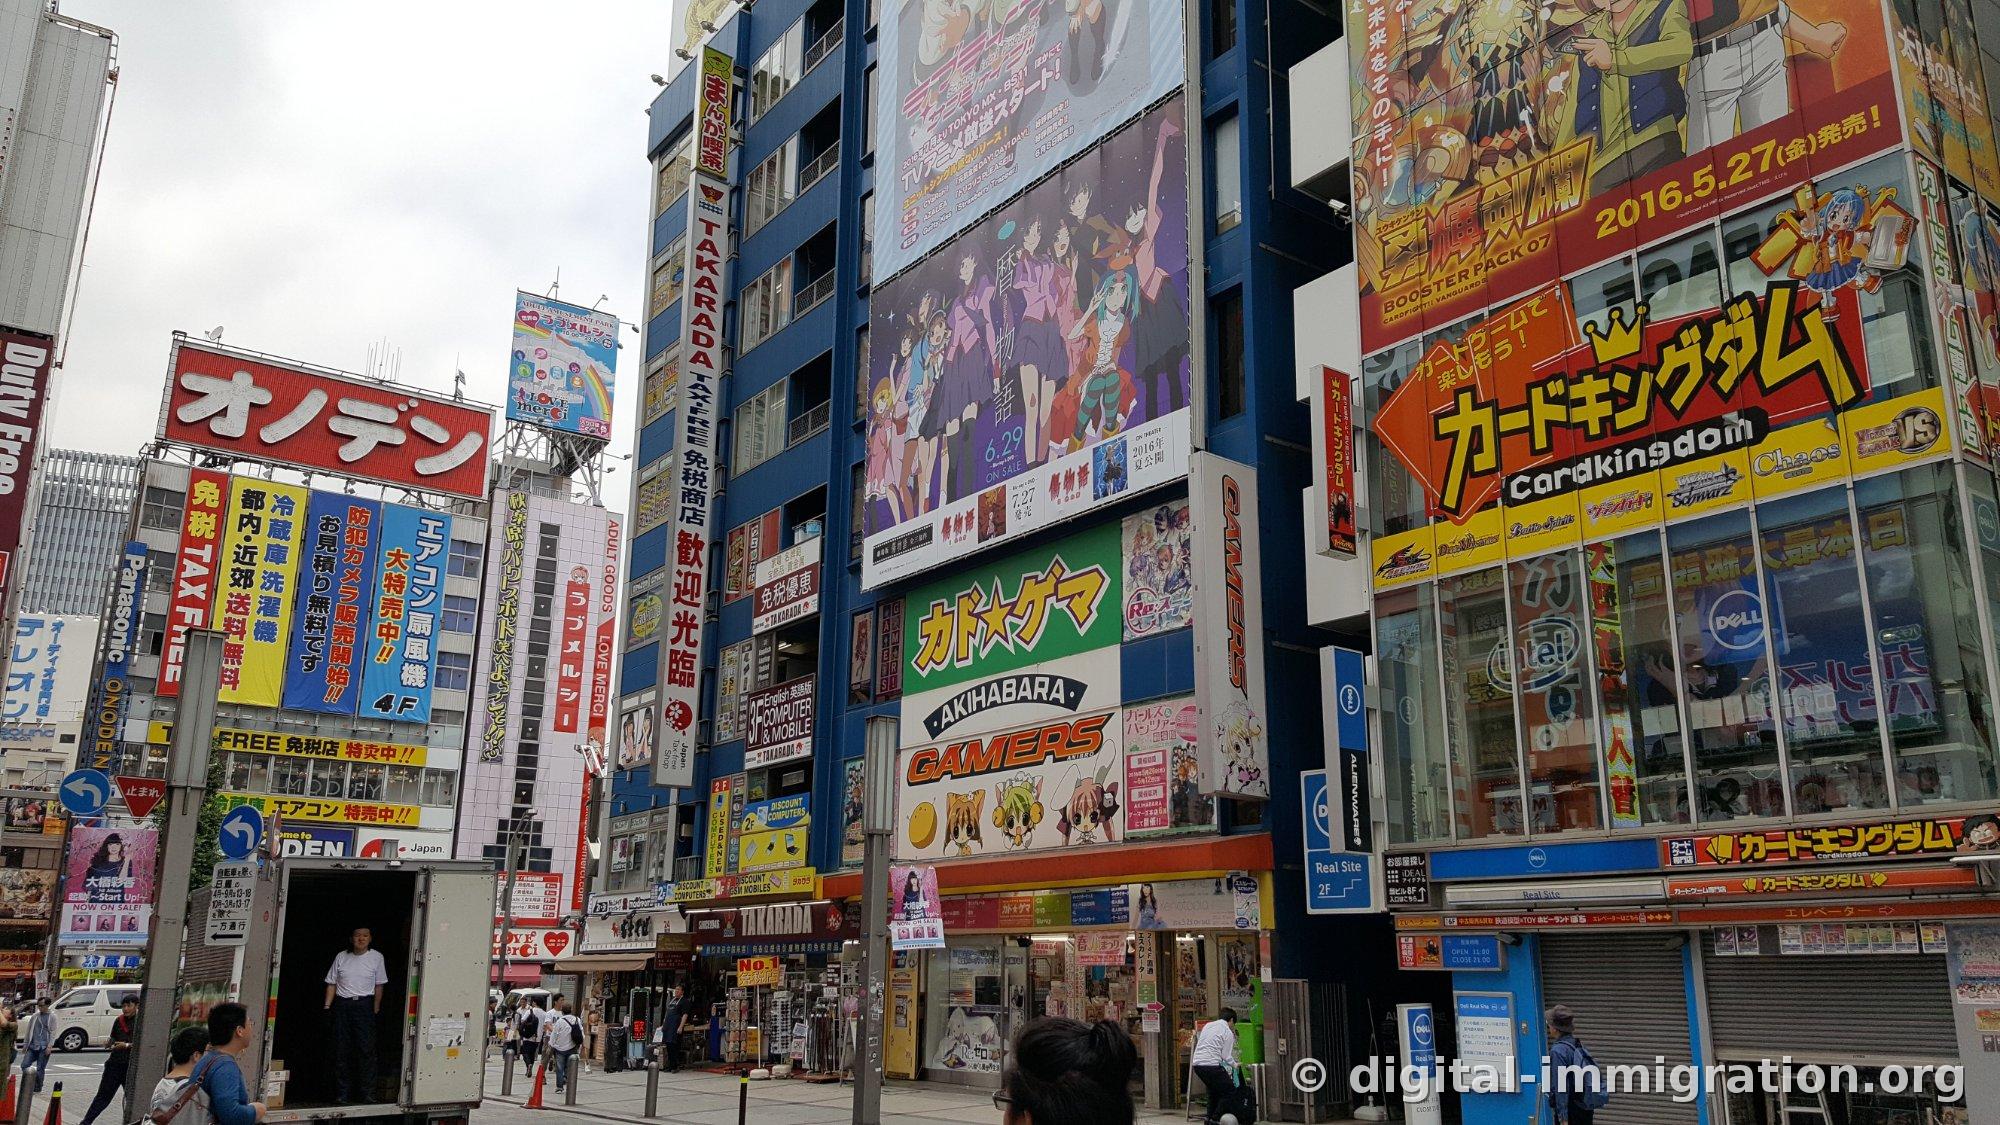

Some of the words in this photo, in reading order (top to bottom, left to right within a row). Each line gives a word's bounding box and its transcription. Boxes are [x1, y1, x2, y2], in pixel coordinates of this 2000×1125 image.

[700, 72, 729, 173] まんが喫茶
[950, 104, 980, 133] TOKYO
[1376, 208, 1424, 236] ユウキケンラン
[1383, 267, 1470, 316] BOOSTER
[1472, 245, 1524, 274] PACK
[1526, 233, 1552, 256] 07
[688, 218, 721, 370] TAKARADA
[541, 314, 613, 338] ラブメルシー
[992, 244, 1017, 427] 暦物語
[1416, 297, 1550, 383] カードゲームで
[1435, 284, 1862, 510] カードキングダム
[177, 370, 484, 475] オノデン
[1899, 412, 1938, 448] VS
[985, 426, 1023, 463] 6.29
[1133, 437, 1165, 458] 2016年
[1331, 389, 1345, 489] カードキングダム
[986, 469, 1000, 483] ON
[1002, 461, 1022, 478] SALE
[1134, 452, 1165, 472] 夏公開
[1753, 443, 1842, 477] Chaos
[678, 449, 709, 527] 免税商店
[1012, 487, 1036, 509] 7.27
[188, 479, 220, 539] 免税
[604, 520, 619, 561] ADULT
[178, 545, 214, 600] TAX
[301, 515, 341, 673] お見積り無料です
[602, 566, 616, 613] GOODS
[1222, 474, 1248, 700] GAMERS
[109, 554, 146, 663] Panasonic
[667, 529, 706, 690] 歓迎光臨
[770, 604, 801, 626] TAKARADA
[1715, 610, 1765, 631] DELL
[559, 591, 587, 726] ラブメルシー
[597, 635, 609, 669] LOVE
[373, 694, 420, 717] 4F
[593, 672, 607, 716] MERCI
[765, 687, 790, 708] English
[790, 681, 812, 699] 英語版
[942, 676, 1065, 730] AKIHABARA
[1346, 688, 1354, 712] DELL
[93, 678, 123, 769] ONODEN
[749, 699, 764, 744] 3F
[763, 697, 811, 727] COMPUTER
[1126, 705, 1164, 723] ガールズ
[219, 731, 280, 751] FREE
[285, 737, 340, 757] 免税店
[763, 729, 771, 745] &
[772, 717, 811, 741] MOBILE
[763, 743, 795, 761] TAKARADA
[907, 713, 1115, 786] GAMERS
[126, 786, 160, 796] 止まれ
[771, 797, 803, 810] DISCOUNT
[1350, 752, 1362, 836] ALIENWARE
[272, 800, 339, 818] エアコン
[767, 807, 806, 822] COMPUTERS
[744, 818, 755, 832] 2F
[1671, 840, 1691, 849] カード
[1672, 848, 1693, 857] ゲーム
[1740, 822, 1954, 862] カードキングダム
[217, 867, 253, 877] 自転車を除く
[1316, 861, 1339, 874] Real
[1341, 860, 1362, 873] Site
[1387, 856, 1426, 867] お部屋探し
[1673, 856, 1694, 865] 専門店
[86, 876, 136, 888] 大橋彩香
[678, 880, 704, 891] DISCOUNT
[736, 874, 766, 885] DISCOUNT
[744, 884, 771, 894] MOBILES
[1318, 883, 1332, 896] 2F
[1762, 873, 1865, 890] カードキングダム
[73, 903, 97, 911] NOW
[100, 903, 115, 911] ON
[674, 889, 706, 900] COMPUTERS
[1523, 890, 1542, 900] Real
[1543, 890, 1560, 900] Site
[741, 905, 813, 936] TAKARADA
[1785, 907, 1871, 918] エレベーター
[210, 921, 246, 931] 一方通行
[740, 957, 779, 972] No.1
[1137, 932, 1145, 980] エスカレーター
[1416, 1025, 1431, 1034] DELL
